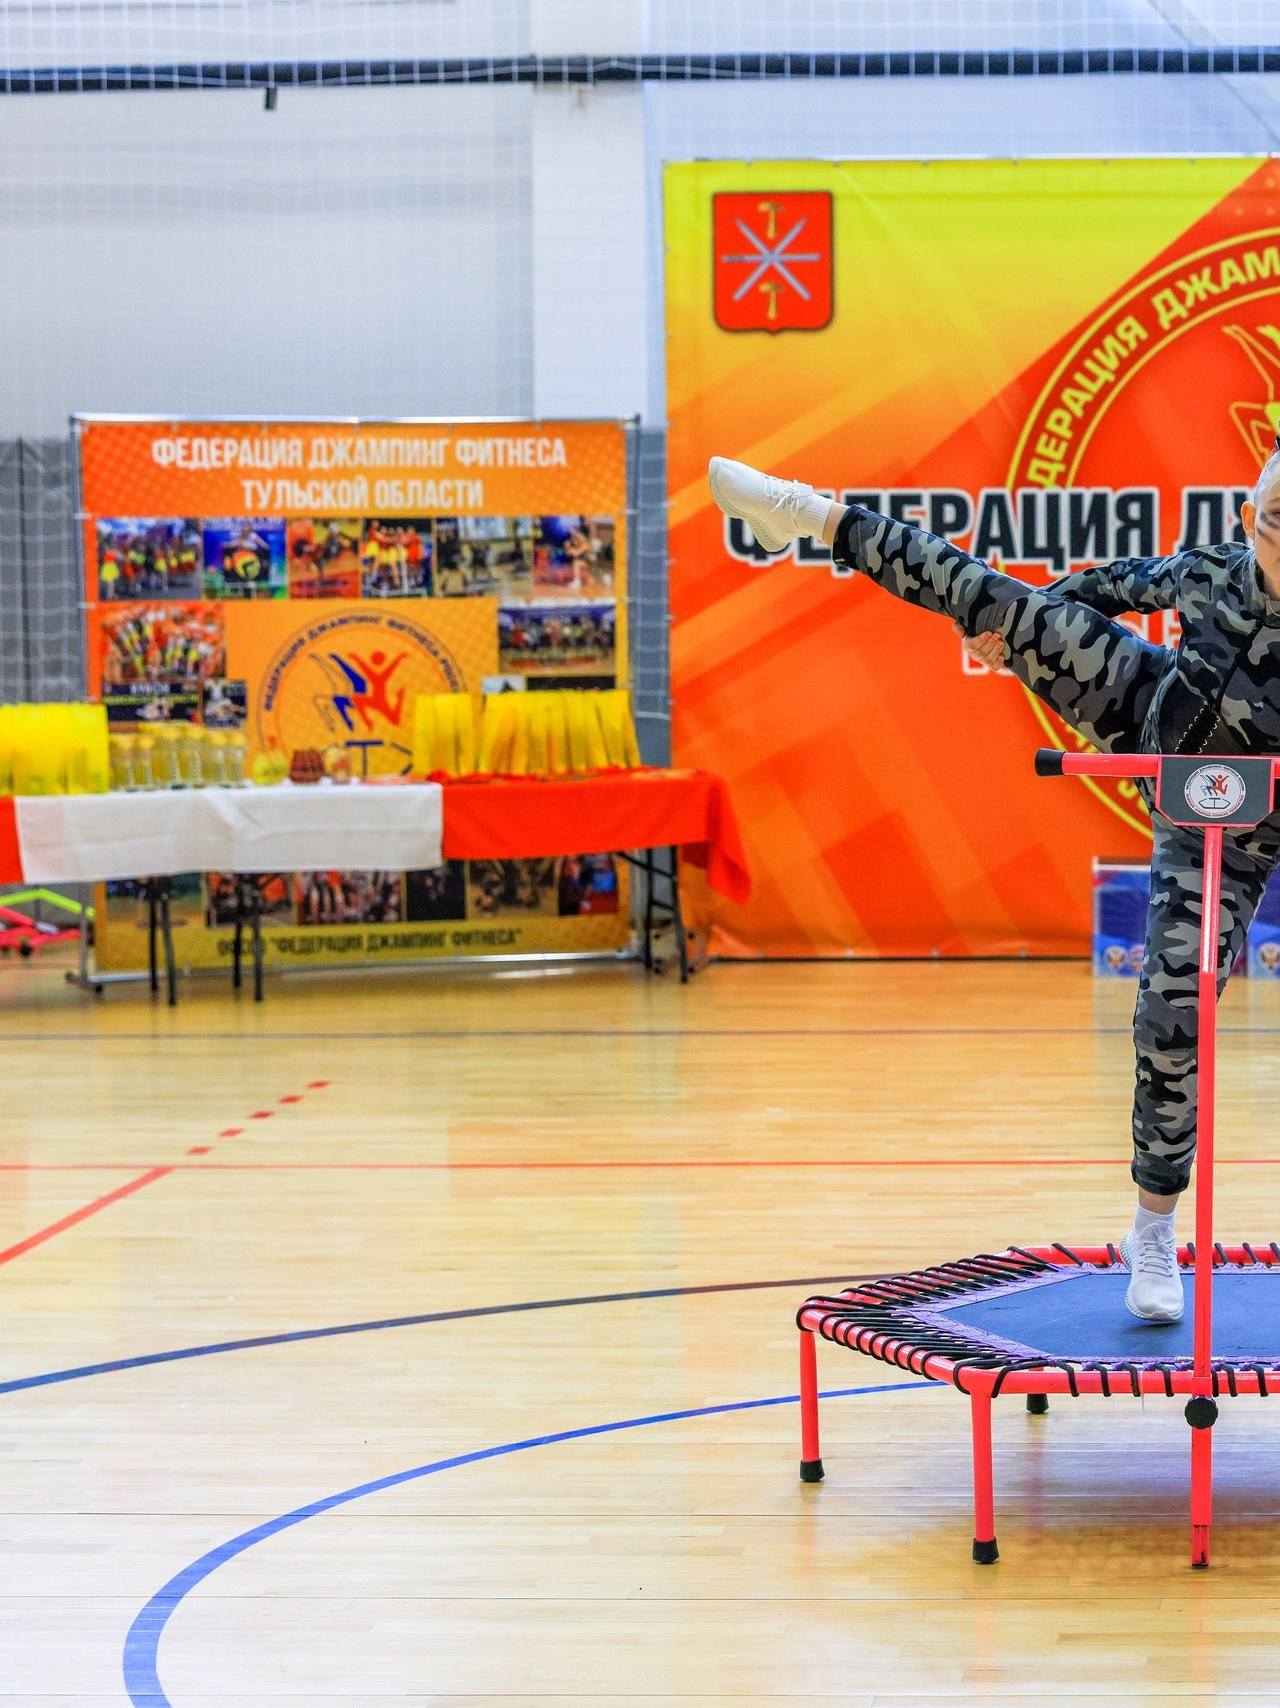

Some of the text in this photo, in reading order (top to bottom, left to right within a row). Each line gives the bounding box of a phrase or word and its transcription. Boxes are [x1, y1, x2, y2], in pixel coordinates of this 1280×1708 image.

[1026, 315, 1148, 491] ДЕРАЦИЯ
[152, 437, 567, 470] ФЕДЕРАЦИЯ ДЖАМПИНГ ФИТНЕСА
[240, 475, 484, 510] ТУЛЬСКОЙ ОБЛАСТИ
